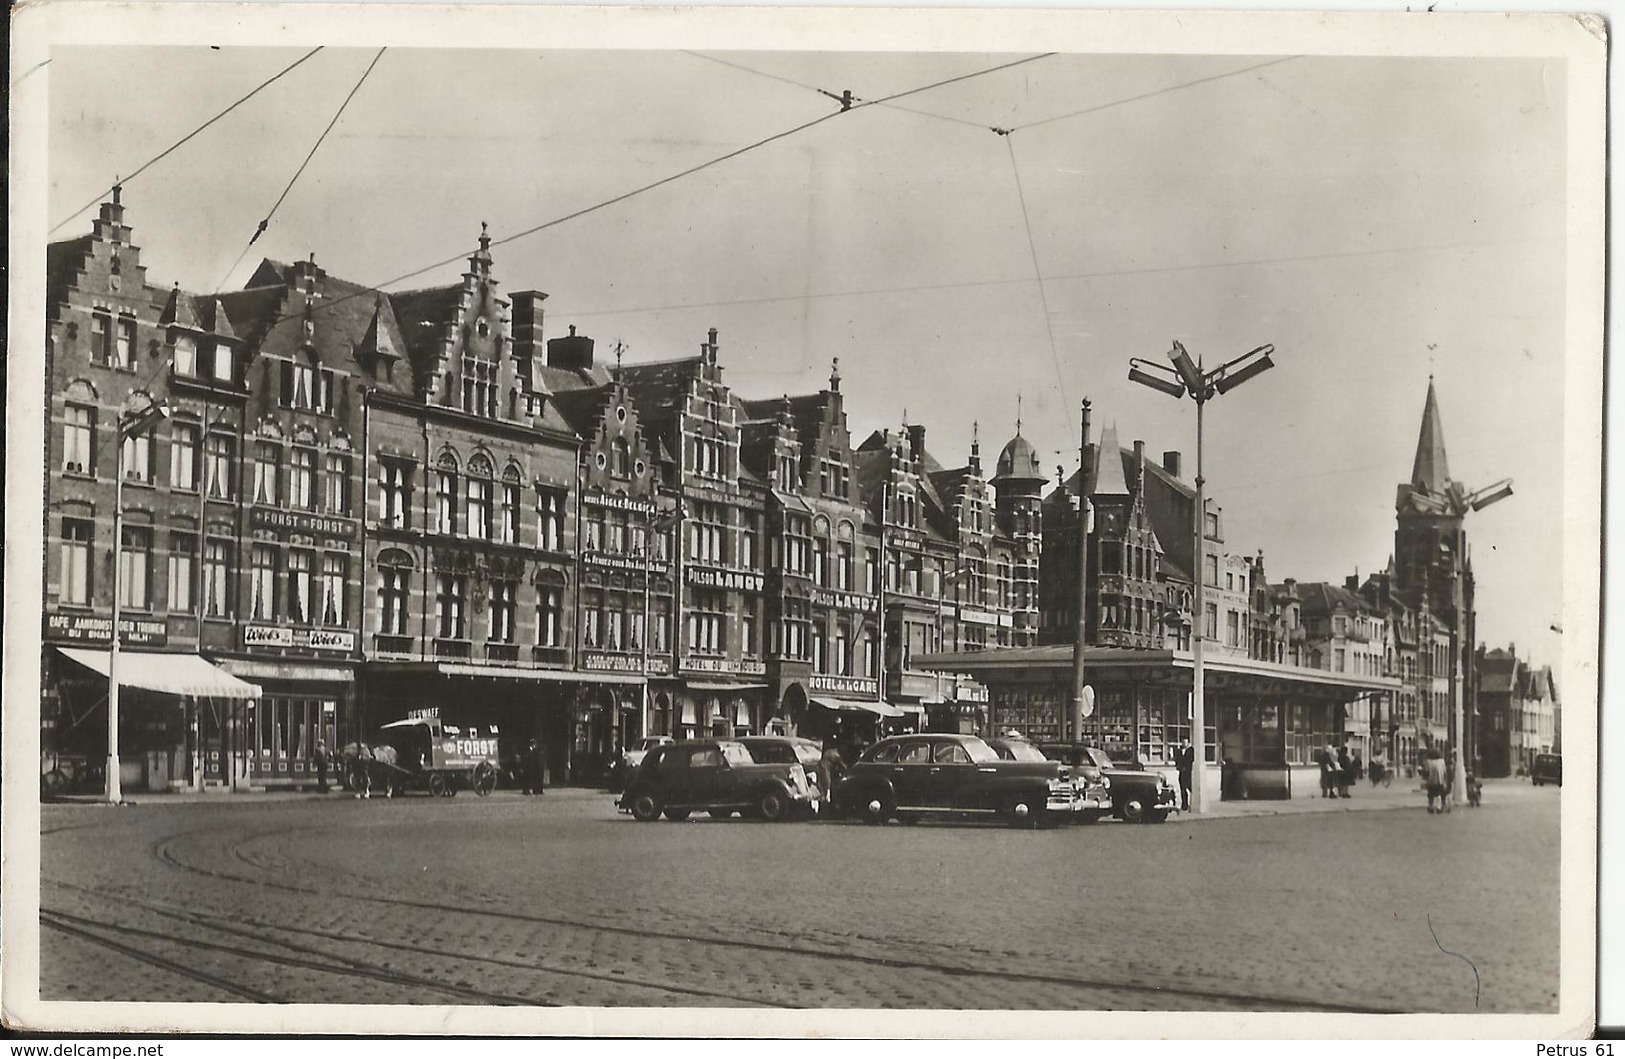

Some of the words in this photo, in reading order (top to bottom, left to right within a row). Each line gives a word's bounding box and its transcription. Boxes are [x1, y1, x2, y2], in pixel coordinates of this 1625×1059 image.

[264, 511, 299, 527] FORST
[310, 518, 343, 533] FORST
[685, 660, 707, 669] HOTEL
[809, 676, 836, 690] HOTEL
[853, 680, 877, 693] GARE
[457, 740, 495, 755] FORST
